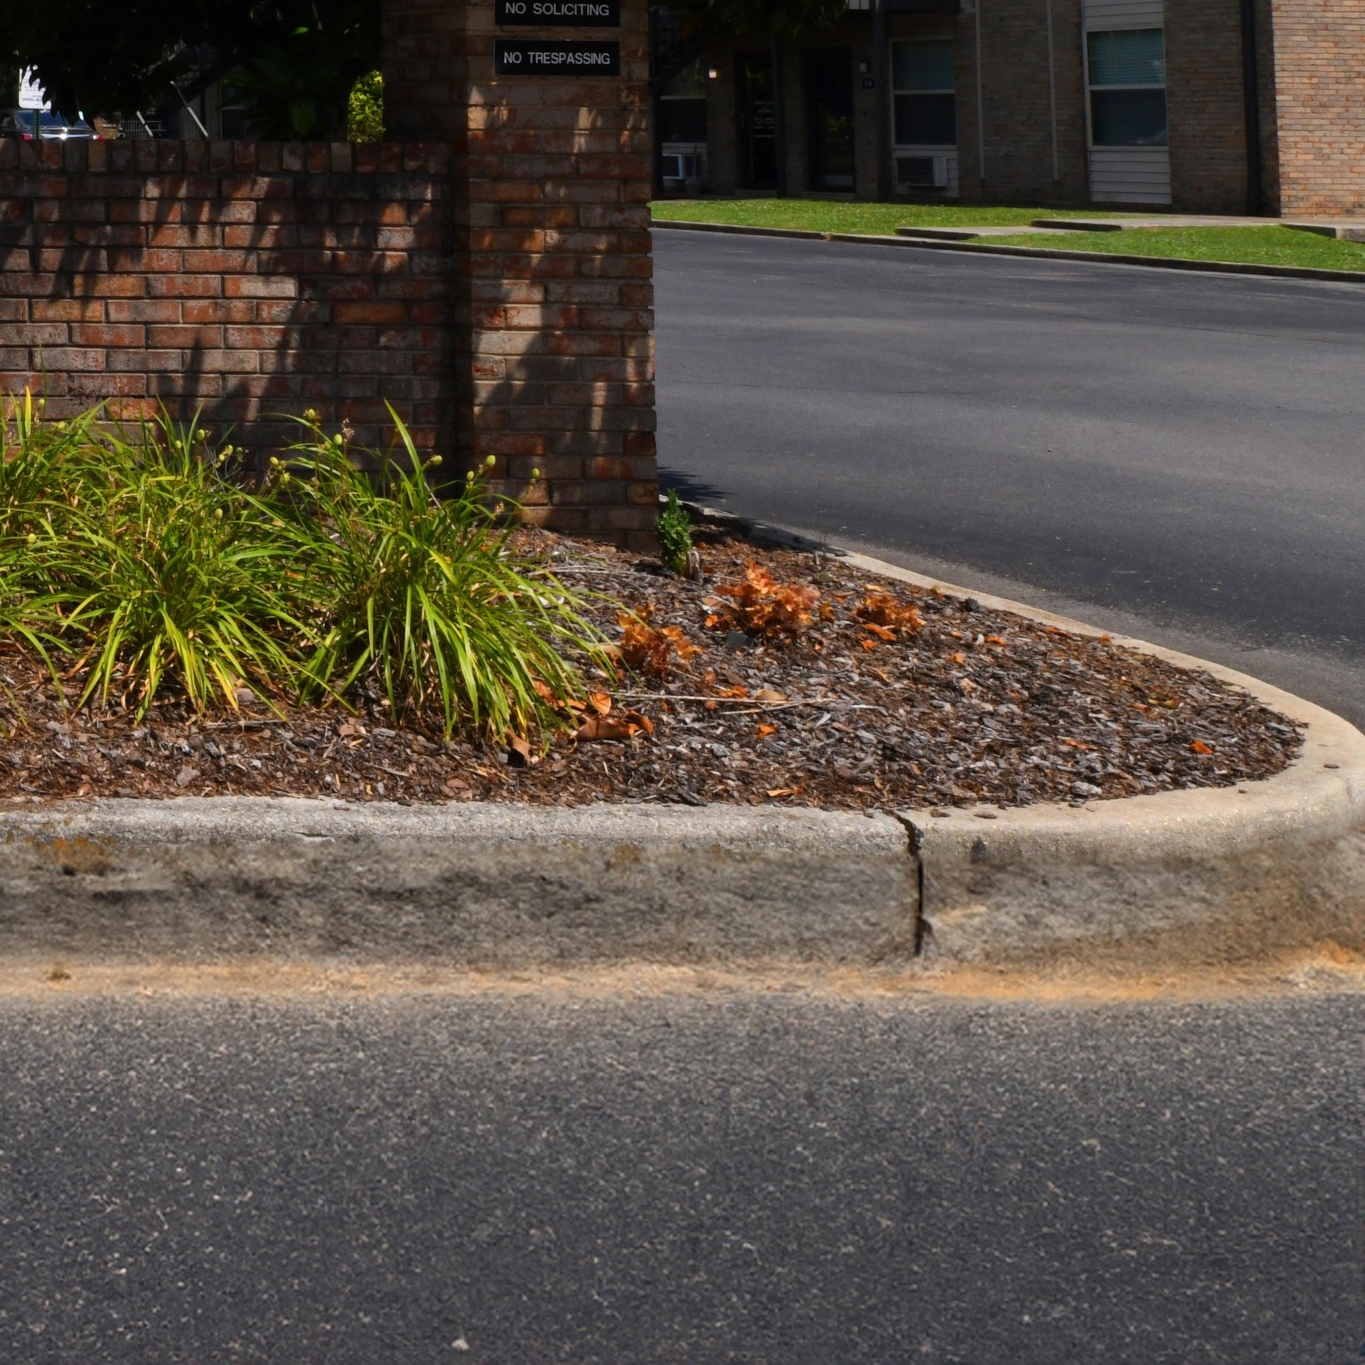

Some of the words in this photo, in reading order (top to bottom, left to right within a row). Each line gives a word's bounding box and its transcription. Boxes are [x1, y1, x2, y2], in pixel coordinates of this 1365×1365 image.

[505, 2, 526, 14] NO
[532, 2, 610, 16] SOLICITING
[503, 51, 522, 64] NO
[527, 51, 611, 65] TRESPASSING
